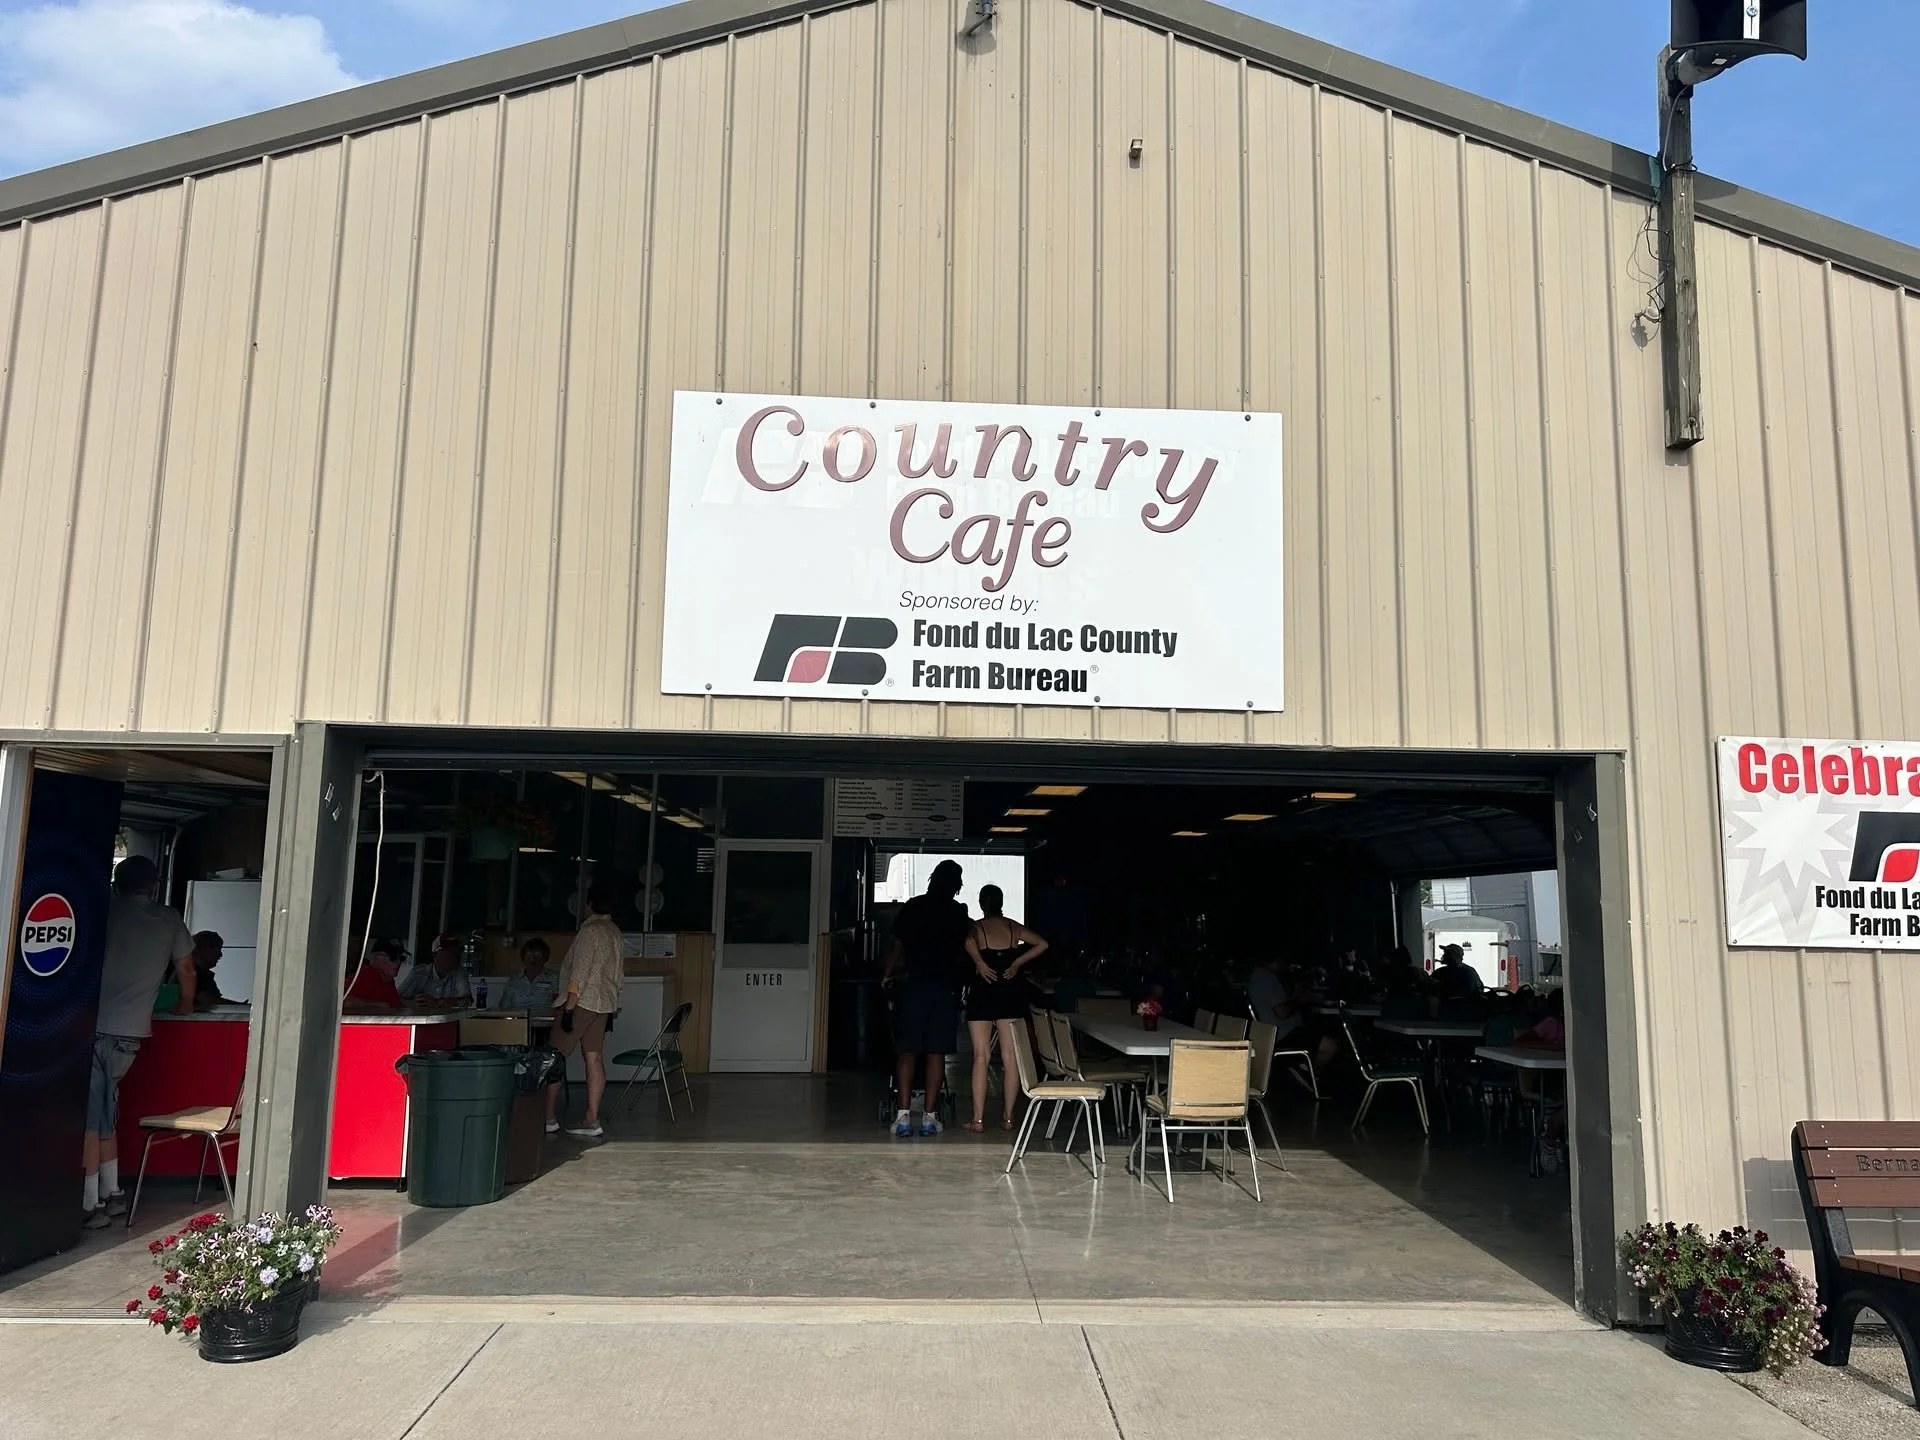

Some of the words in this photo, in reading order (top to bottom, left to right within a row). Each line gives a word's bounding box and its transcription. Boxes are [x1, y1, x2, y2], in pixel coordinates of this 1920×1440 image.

[736, 405, 1219, 534] Country
[889, 487, 1072, 592] Cafe
[900, 590, 1004, 612] Sponsored
[1010, 595, 1039, 615] by:
[913, 619, 979, 648] Fond
[986, 621, 1020, 650] du
[1027, 623, 1073, 652] Lac
[1080, 624, 1178, 658] County
[912, 659, 980, 689] Farm
[1815, 885, 1865, 908] Fond
[1870, 887, 1896, 909] du
[24, 926, 73, 943] PEPSI
[1850, 913, 1901, 936] Farm
[746, 973, 783, 986] ENTER
